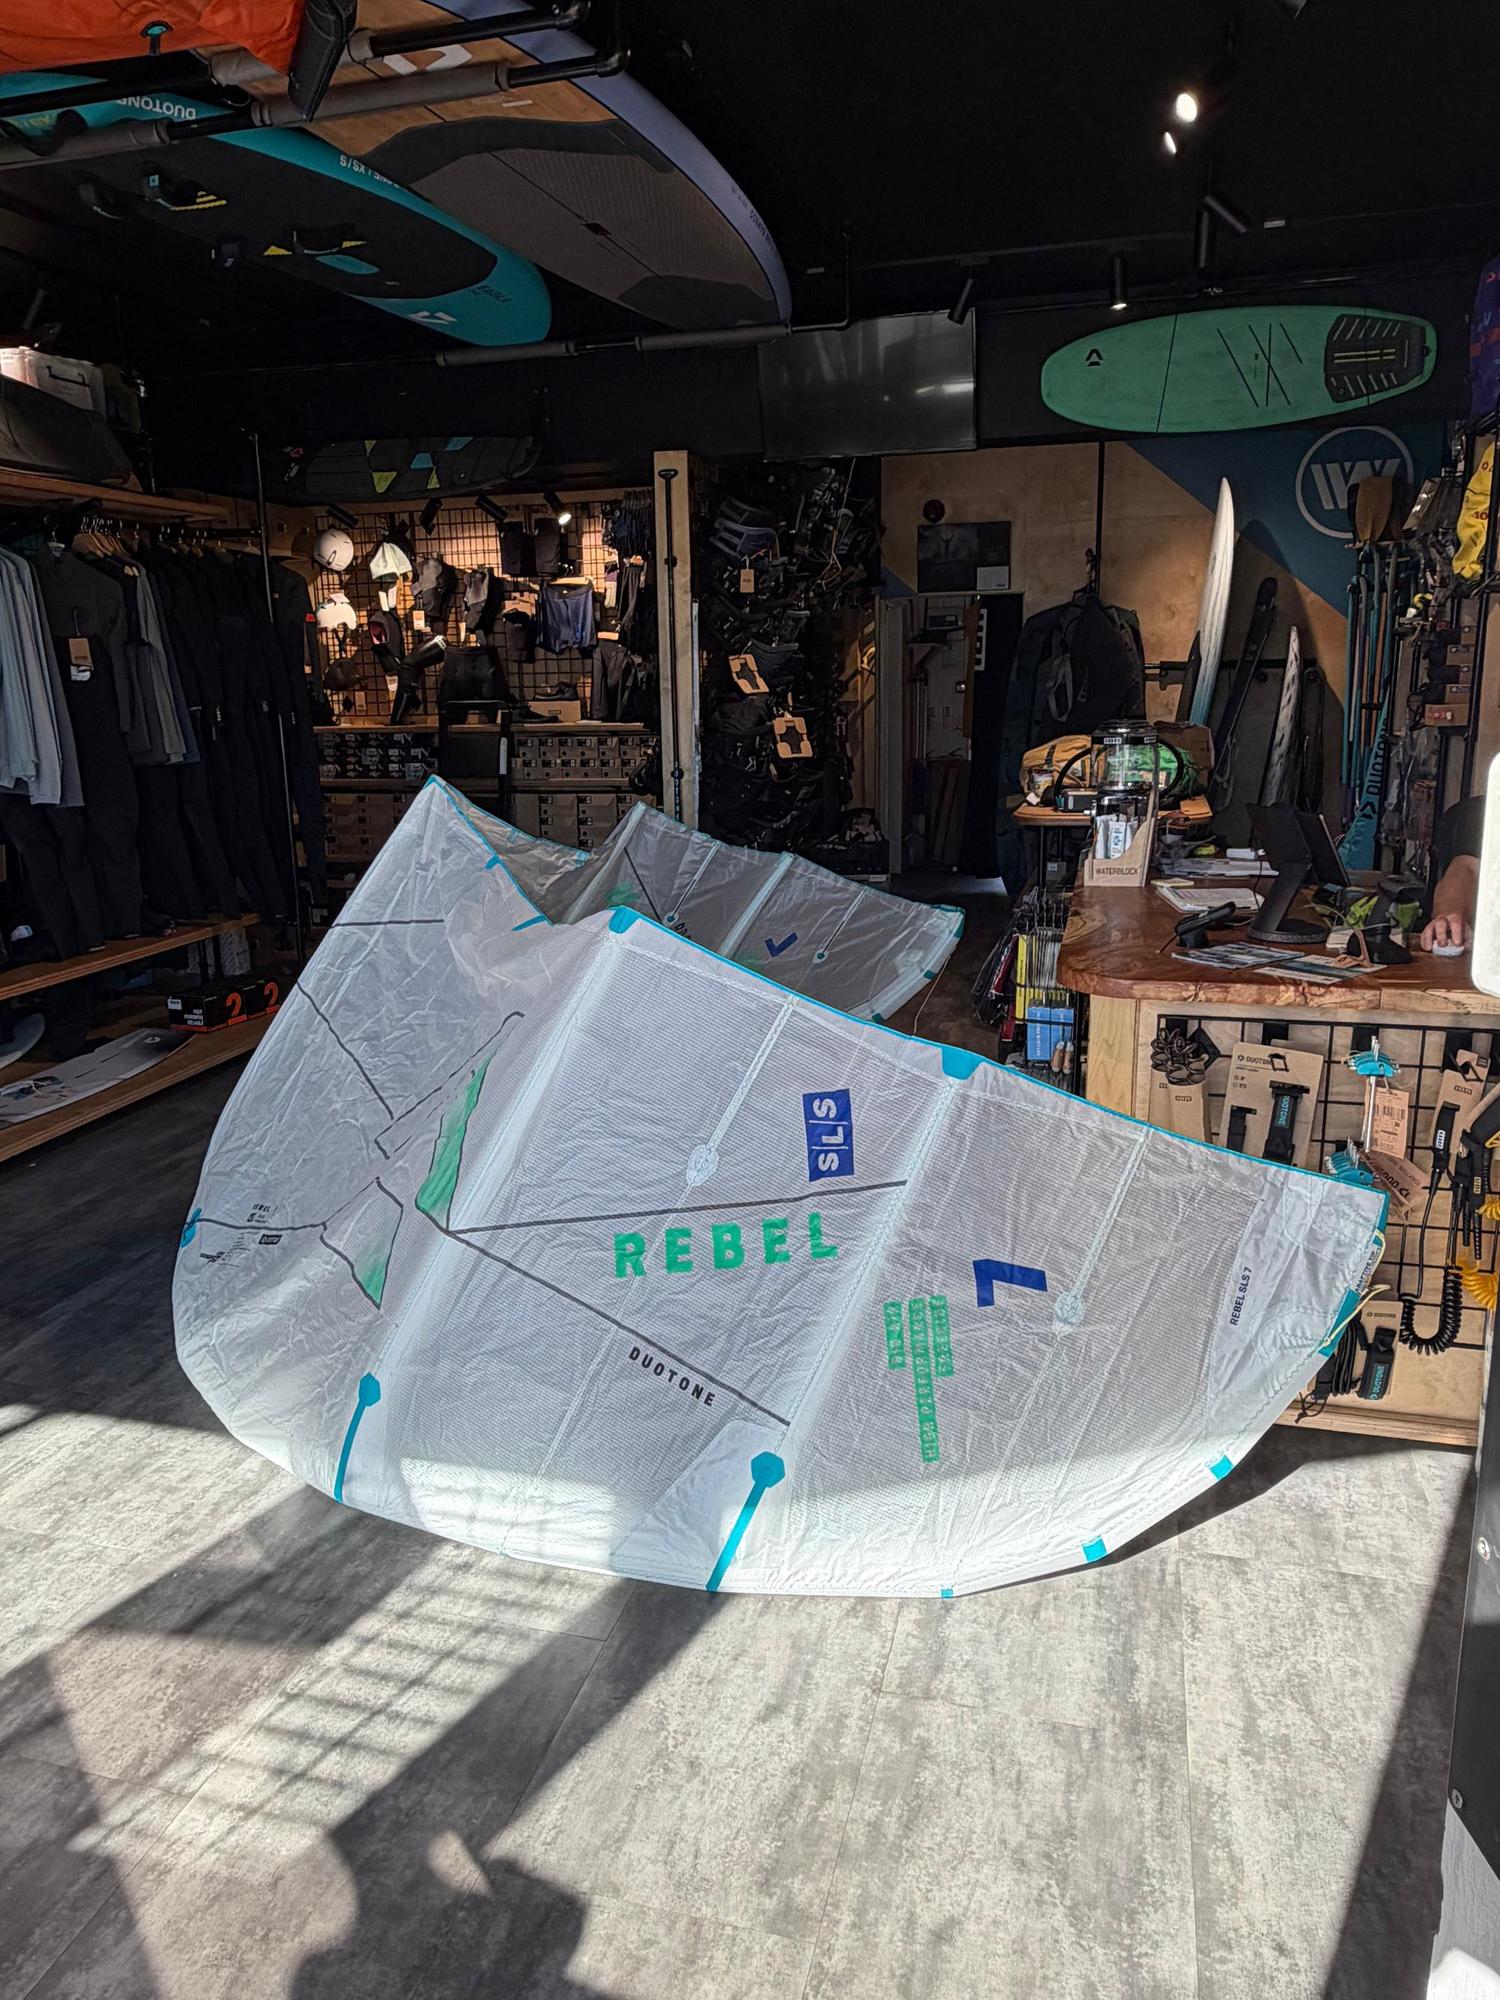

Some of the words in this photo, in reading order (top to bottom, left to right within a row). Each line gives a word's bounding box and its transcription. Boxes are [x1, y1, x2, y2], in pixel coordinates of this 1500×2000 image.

[1095, 866, 1139, 877] WATERBLOCK
[1246, 1056, 1272, 1065] DUOTON
[613, 1211, 839, 1279] REBEL
[1243, 1266, 1252, 1274] 7
[972, 1258, 1048, 1308] 7
[1238, 1275, 1251, 1294] SLS
[1229, 1295, 1246, 1326] REBEL
[628, 1346, 716, 1407] DUOTONE
